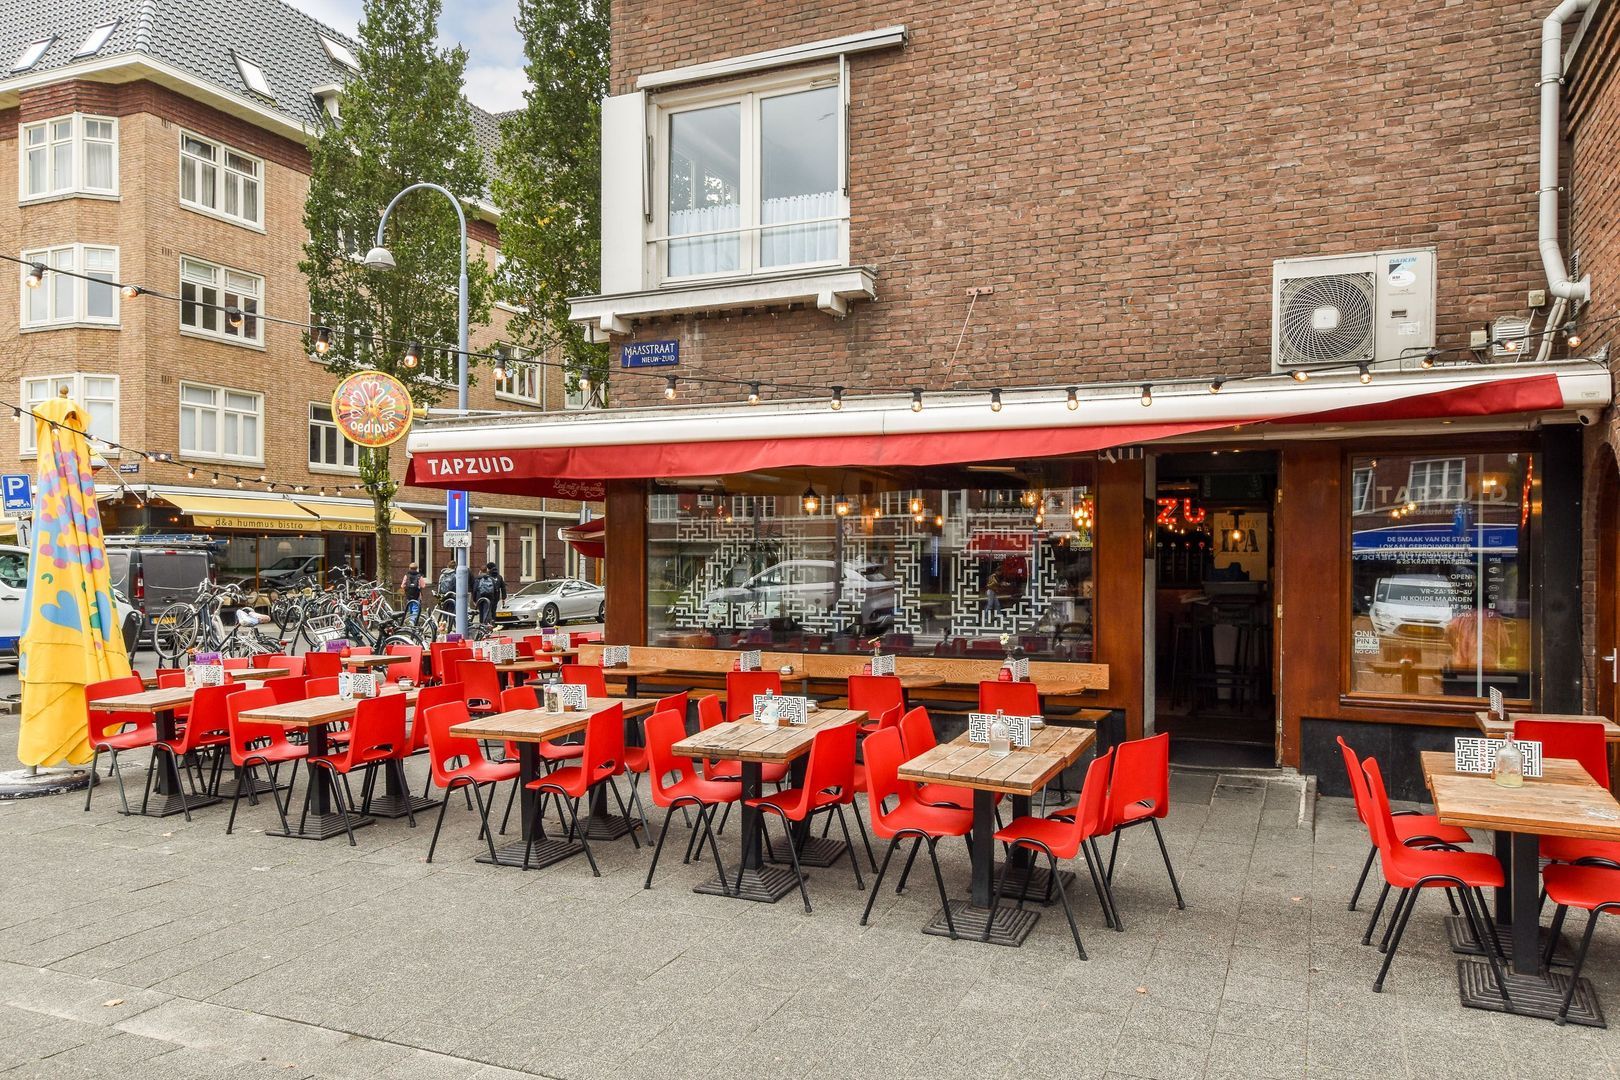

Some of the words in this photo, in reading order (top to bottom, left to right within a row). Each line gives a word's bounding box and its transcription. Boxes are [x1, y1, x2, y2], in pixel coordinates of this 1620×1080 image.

[624, 343, 675, 356] MAASSTRAAT
[641, 354, 676, 363] NIEUW-ZUID
[350, 418, 395, 436] oedipus
[427, 456, 515, 475] TAPZUID
[8, 477, 24, 495] P
[215, 517, 233, 527] d&a
[237, 518, 274, 528] hummus
[278, 520, 304, 530] bistro
[337, 522, 352, 530] d&a
[355, 523, 376, 532] humm
[1219, 528, 1260, 553] IPA
